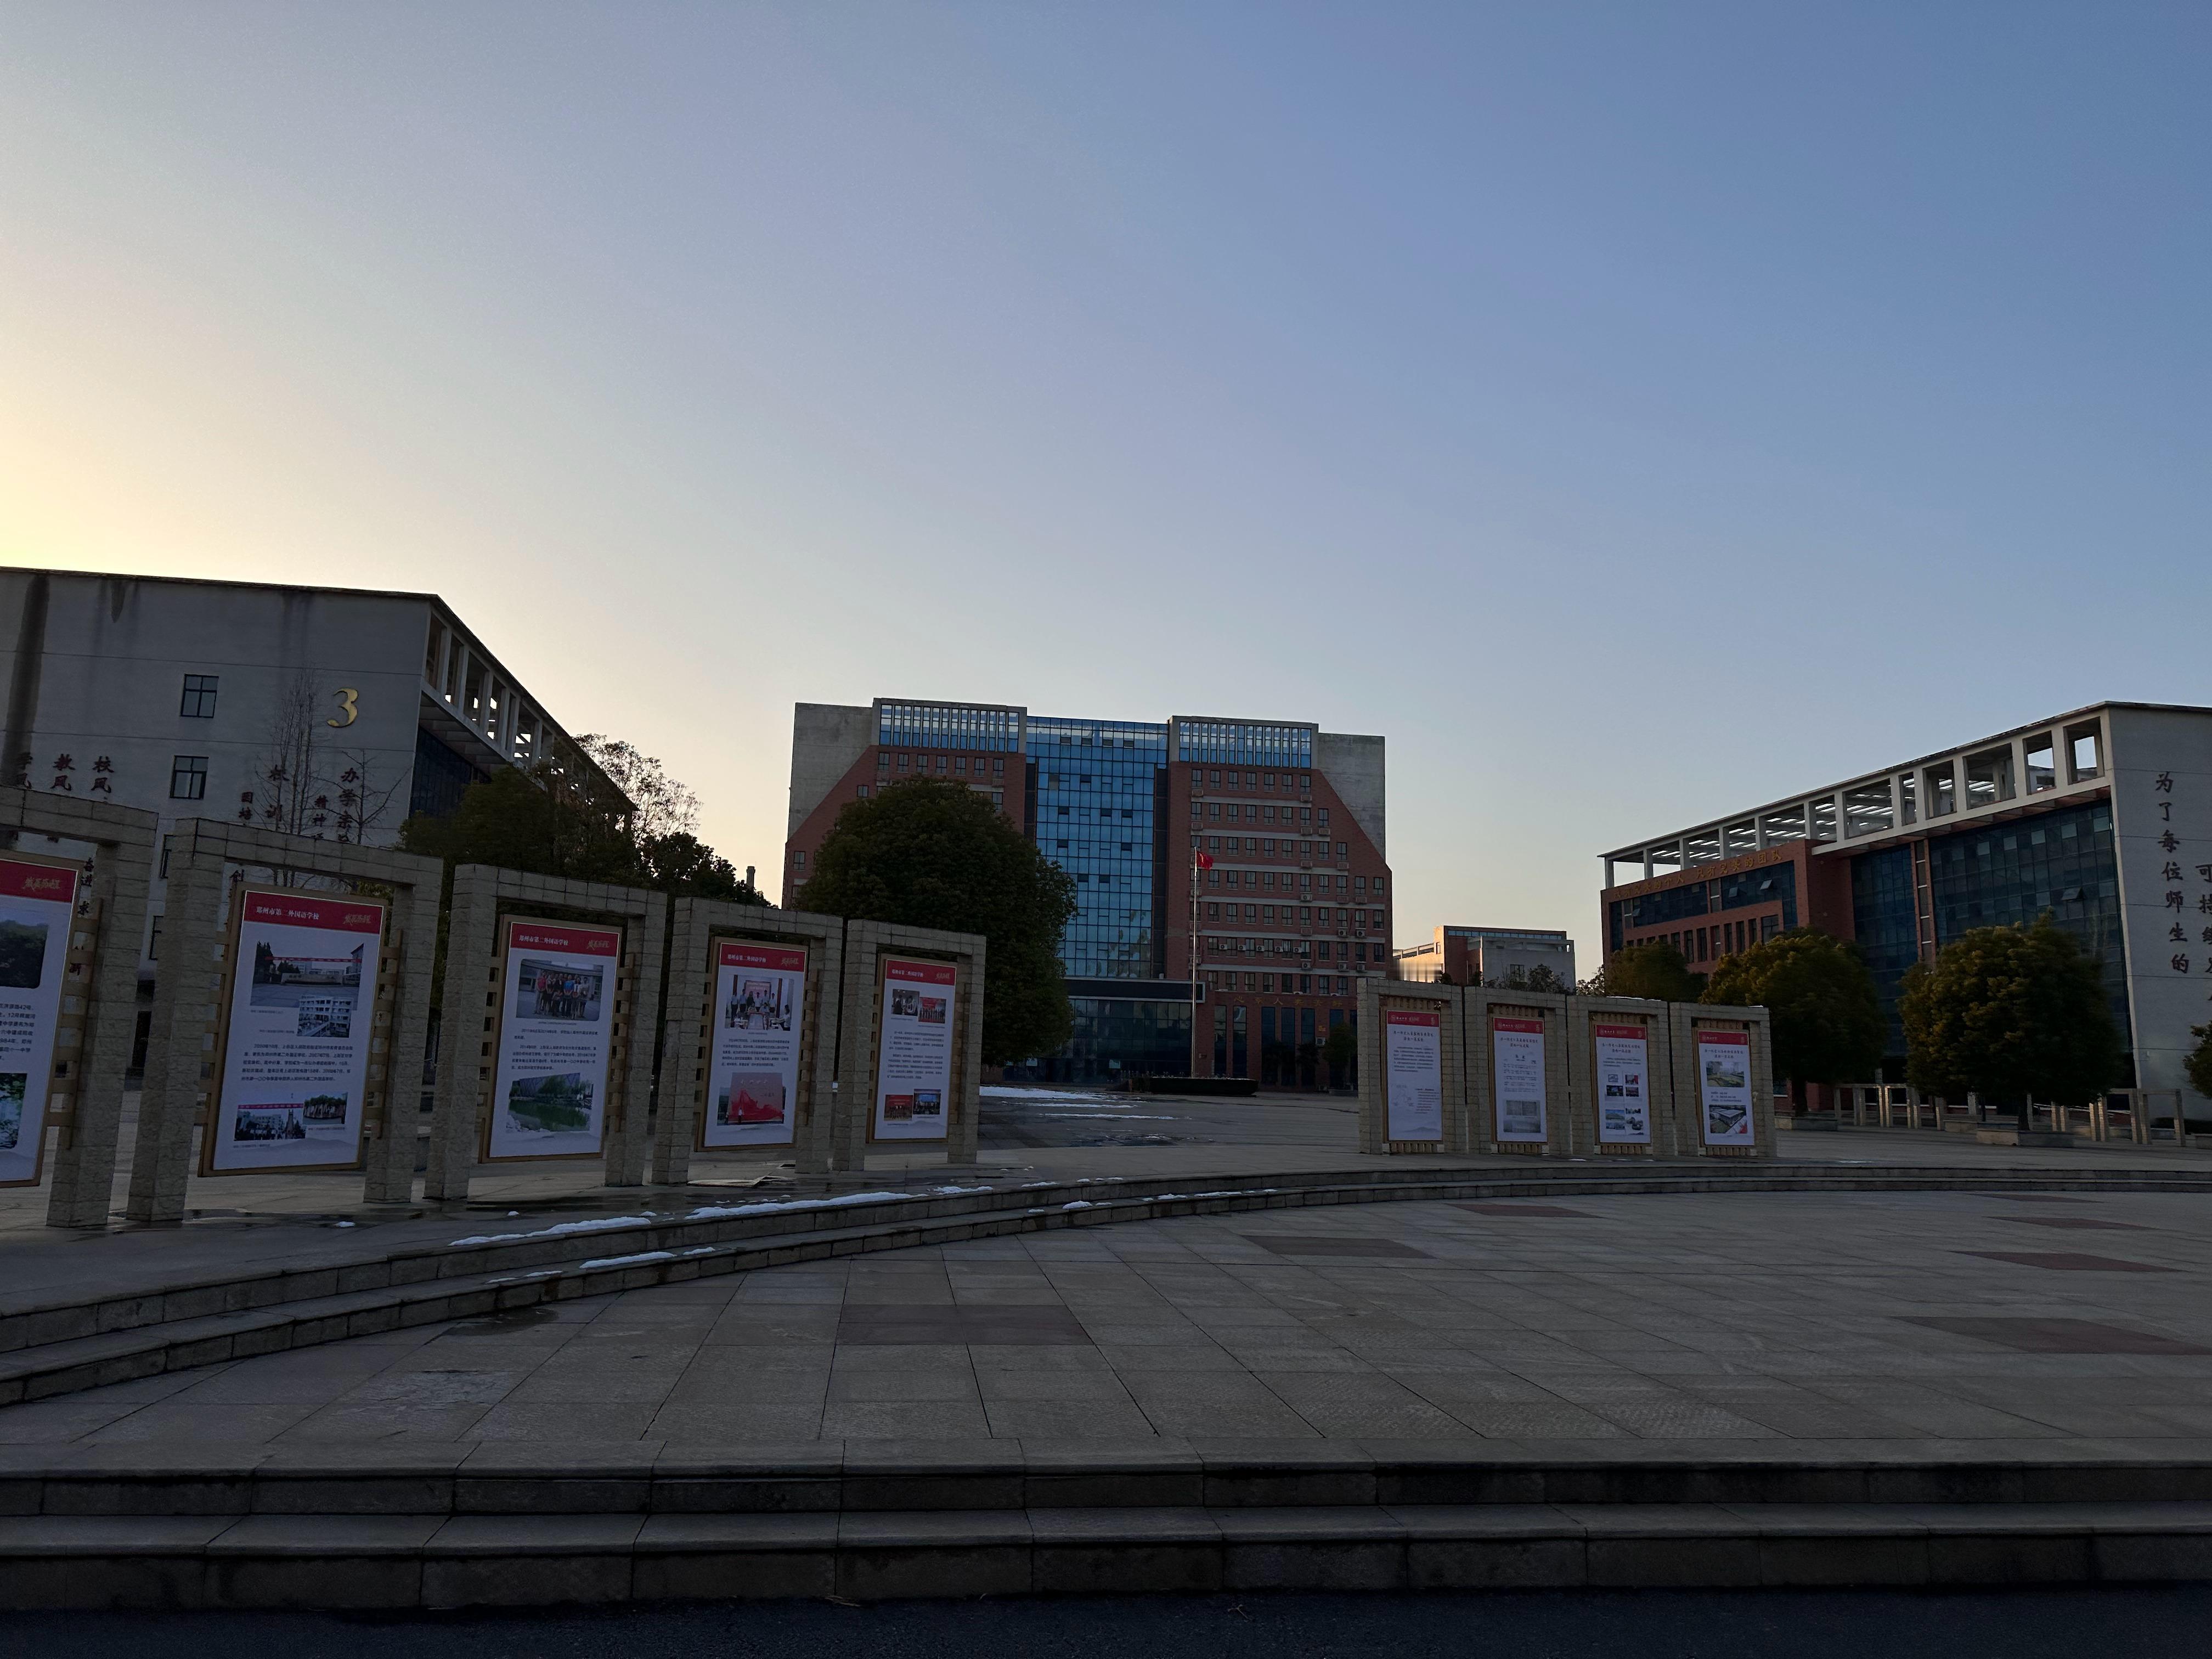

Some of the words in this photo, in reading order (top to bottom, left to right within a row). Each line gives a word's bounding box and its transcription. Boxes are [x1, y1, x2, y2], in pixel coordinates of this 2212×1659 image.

[326, 687, 359, 729] 3
[1696, 849, 1782, 879] 只有完美的团队
[2155, 770, 2190, 974] 为了每位师生的
[256, 906, 320, 920] 郑州市第二外国语学校
[2195, 864, 2212, 1001] 可持续
